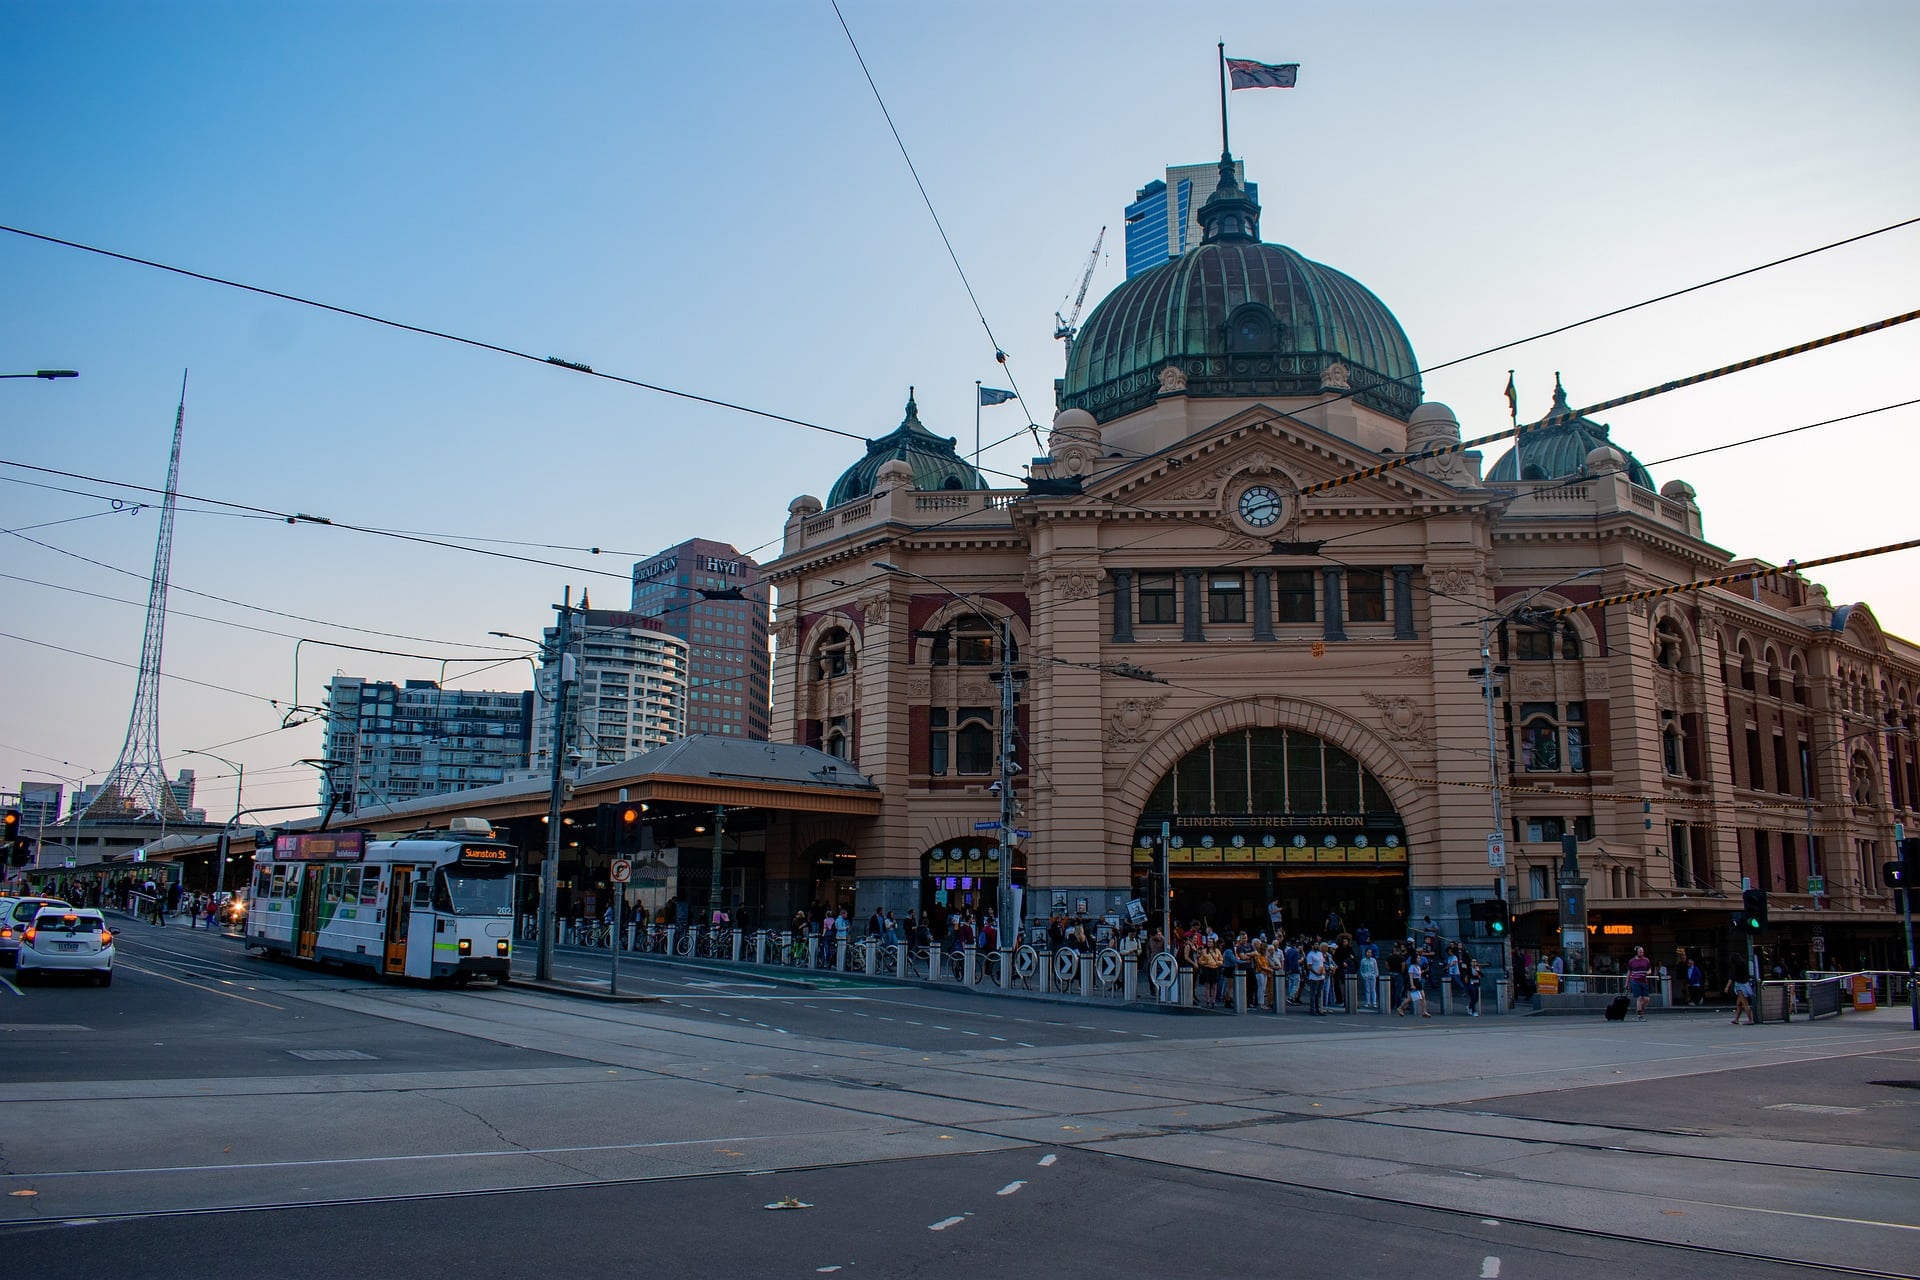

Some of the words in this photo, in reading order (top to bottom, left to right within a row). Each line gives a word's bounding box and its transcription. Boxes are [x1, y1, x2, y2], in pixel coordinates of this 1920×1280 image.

[661, 556, 678, 572] SUN
[706, 557, 738, 575] HWT
[1176, 816, 1235, 827] FLINDERS
[1250, 816, 1295, 827] STREET
[1309, 816, 1365, 827] STATION
[465, 847, 498, 859] Swanston
[498, 849, 507, 860] St
[497, 906, 512, 915] 202
